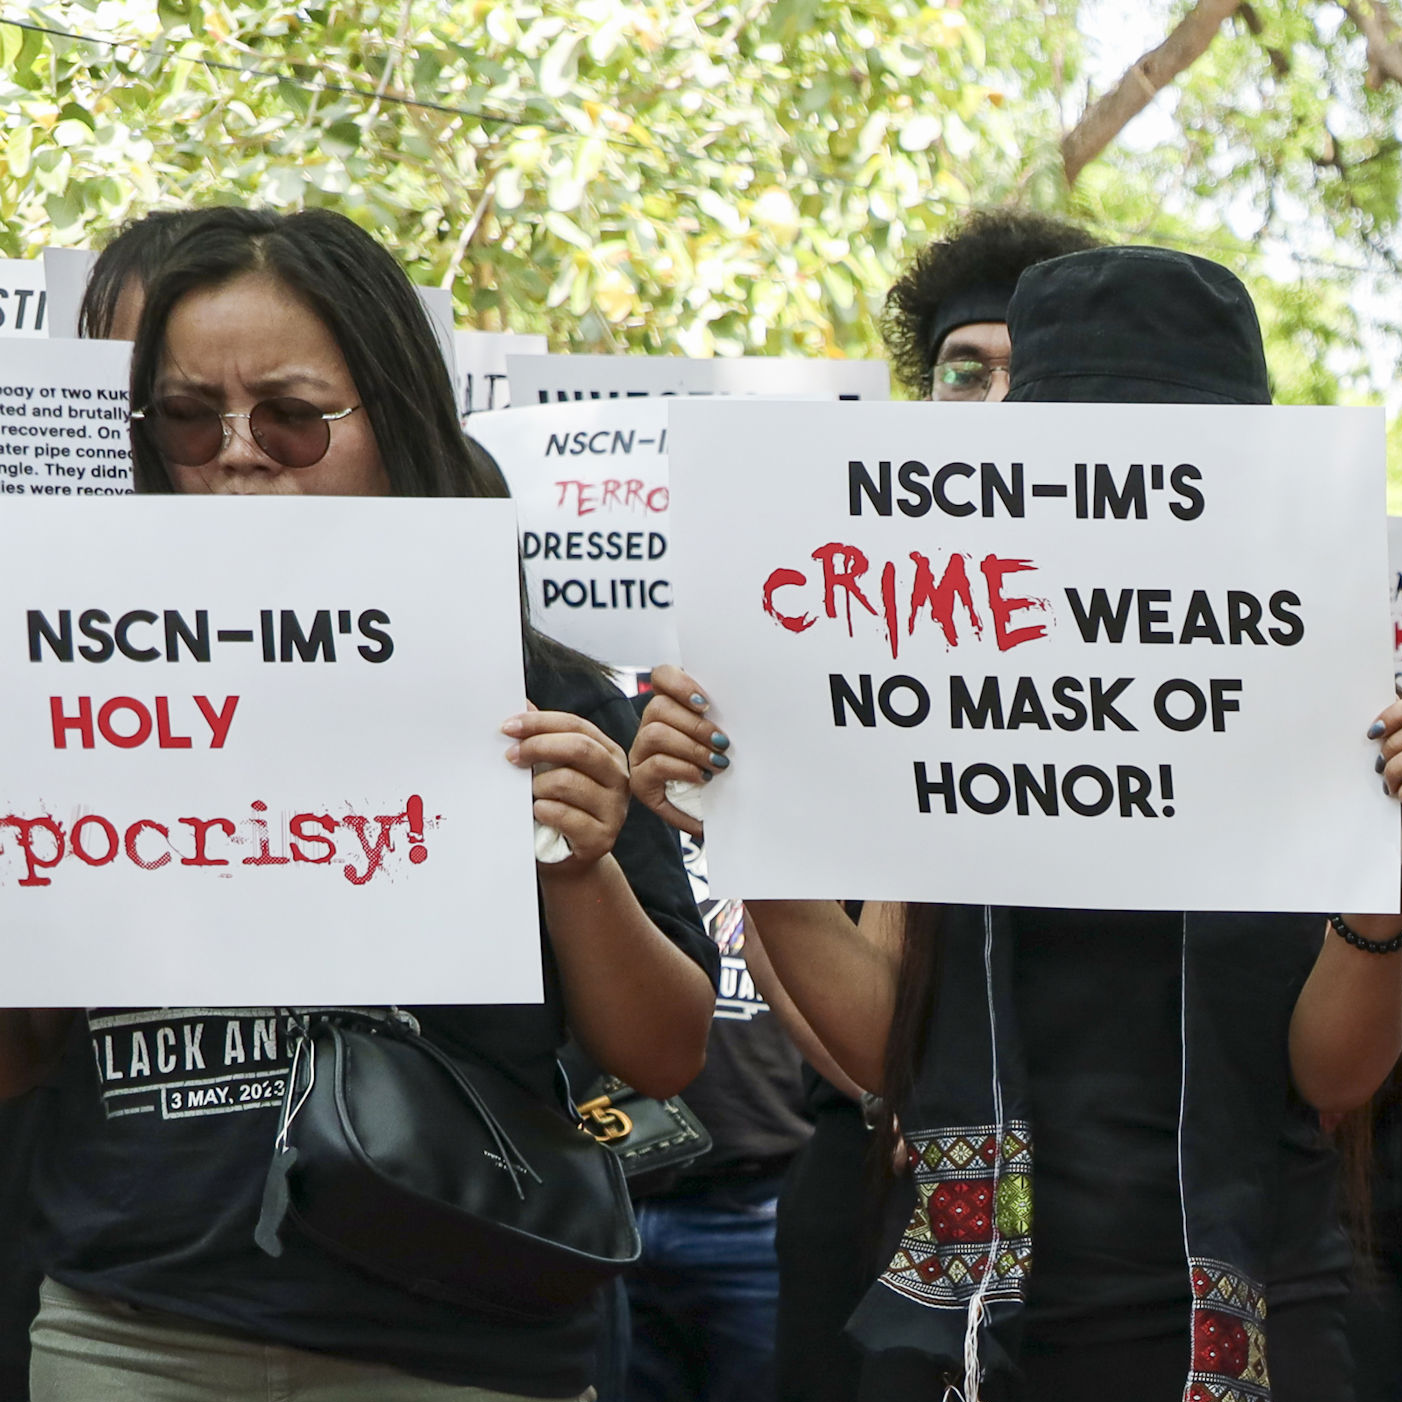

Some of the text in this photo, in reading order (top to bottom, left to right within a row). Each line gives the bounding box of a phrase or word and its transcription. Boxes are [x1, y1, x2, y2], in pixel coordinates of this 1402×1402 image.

[0, 386, 34, 401] ody
[61, 387, 92, 400] two
[32, 404, 63, 418] and
[68, 405, 132, 423] brutally
[1, 425, 121, 439] recovered. On
[34, 443, 70, 459] pipe
[45, 462, 86, 480] They
[30, 484, 72, 496] were
[848, 460, 1205, 522] NSCN-IM'S
[523, 531, 667, 560] DRESSED
[543, 577, 671, 609] POLITIC
[762, 541, 1305, 660] CRIME WEARS
[27, 608, 395, 664] NSCN-IM'S
[828, 673, 1243, 733] NO MASK OF
[49, 695, 240, 750] HOLY
[913, 759, 1176, 820] HONOR!
[0, 794, 426, 886] pocrisy!
[93, 1022, 207, 1084] LACK
[171, 1092, 182, 1110] 3
[187, 1086, 234, 1109] MAY,
